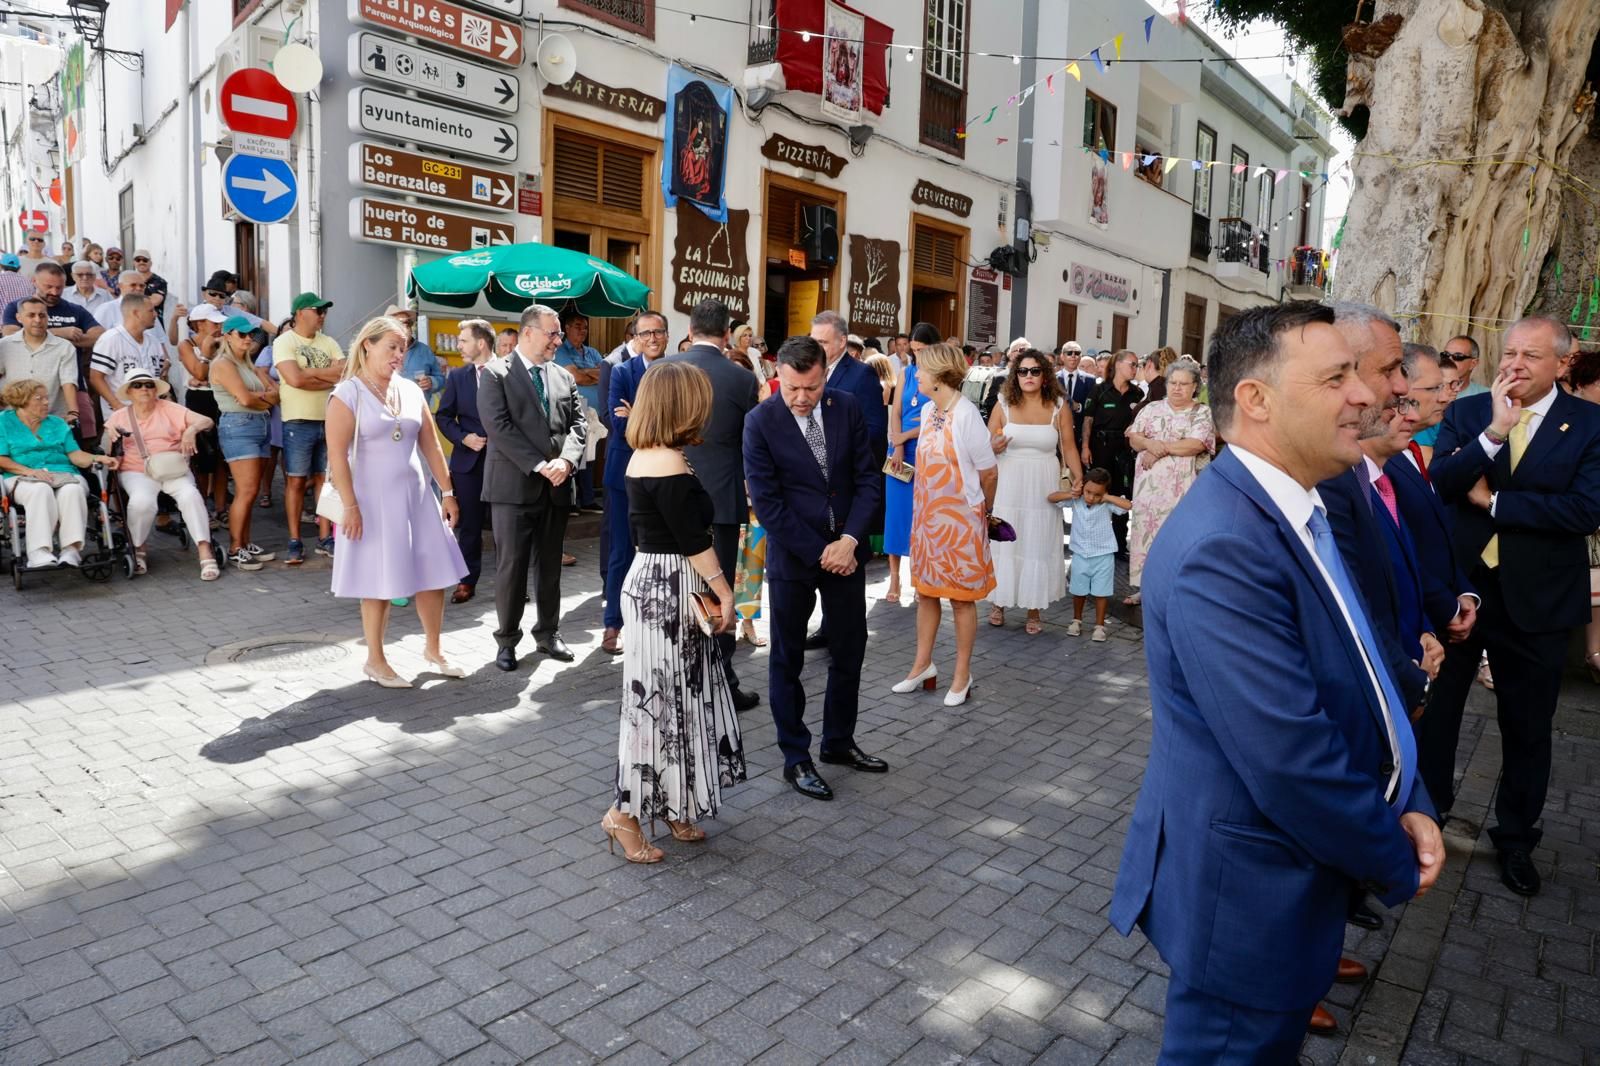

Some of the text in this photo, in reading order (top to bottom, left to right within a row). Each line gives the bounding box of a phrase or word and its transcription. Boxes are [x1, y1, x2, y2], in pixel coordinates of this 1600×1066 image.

[365, 5, 455, 40] Parque Arqueológico
[368, 0, 455, 28] aipés
[365, 104, 473, 139] ayuntamiento
[365, 148, 393, 166] Los
[777, 141, 831, 170] PIZZERÍA
[365, 165, 447, 195] Berrazales
[423, 162, 461, 178] GC-231
[365, 203, 445, 229] huerto de
[365, 220, 448, 247] Las Flores
[685, 245, 701, 262] LA
[515, 273, 572, 291] Carlsberg
[679, 266, 746, 292] ESQUINA DE
[853, 282, 863, 294] EL
[852, 310, 895, 327] DE AGAETE
[854, 297, 896, 315] SEMÁFORO
